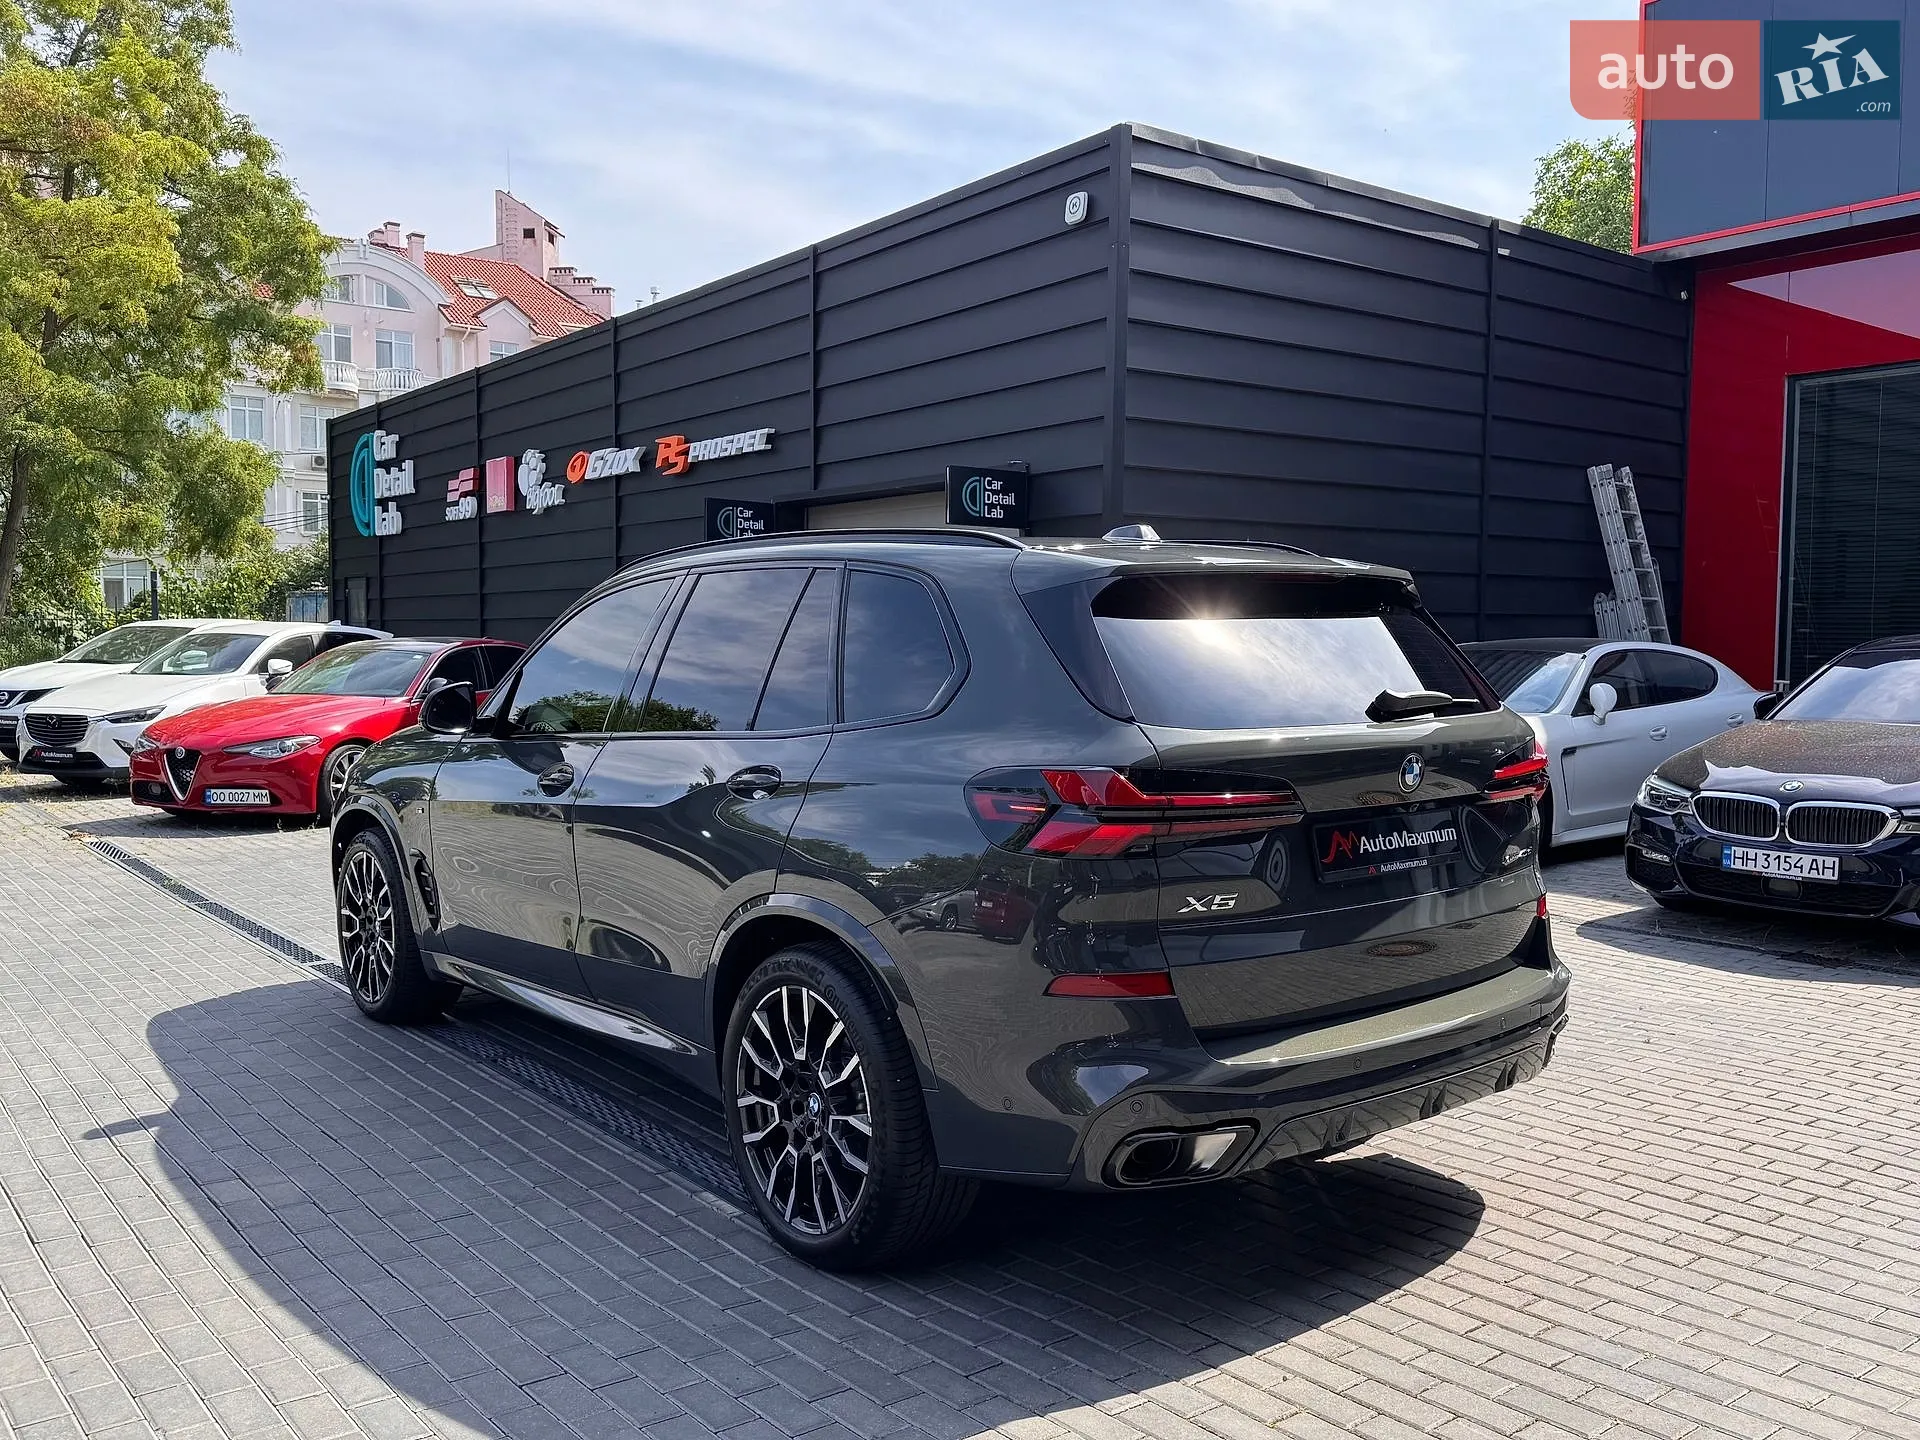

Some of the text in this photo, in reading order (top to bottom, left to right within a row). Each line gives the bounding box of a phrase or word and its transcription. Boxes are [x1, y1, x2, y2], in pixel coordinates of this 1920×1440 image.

[373, 429, 400, 461] Car
[687, 427, 776, 463] PROSPEC
[373, 460, 416, 499] Detail
[985, 477, 1003, 490] Car
[985, 491, 1016, 506] Detail
[374, 502, 403, 536] Lab
[737, 507, 754, 518] Car
[985, 505, 1004, 519] Lab
[737, 518, 765, 530] Detail
[211, 791, 226, 802] OO
[228, 791, 250, 802] 0027
[253, 791, 269, 802] MM
[1359, 827, 1457, 854] AutoMaximum
[1380, 858, 1428, 873] AutoMaximum.ua
[1732, 849, 1836, 878] HH 3154 AH
[1177, 892, 1239, 913] X5
